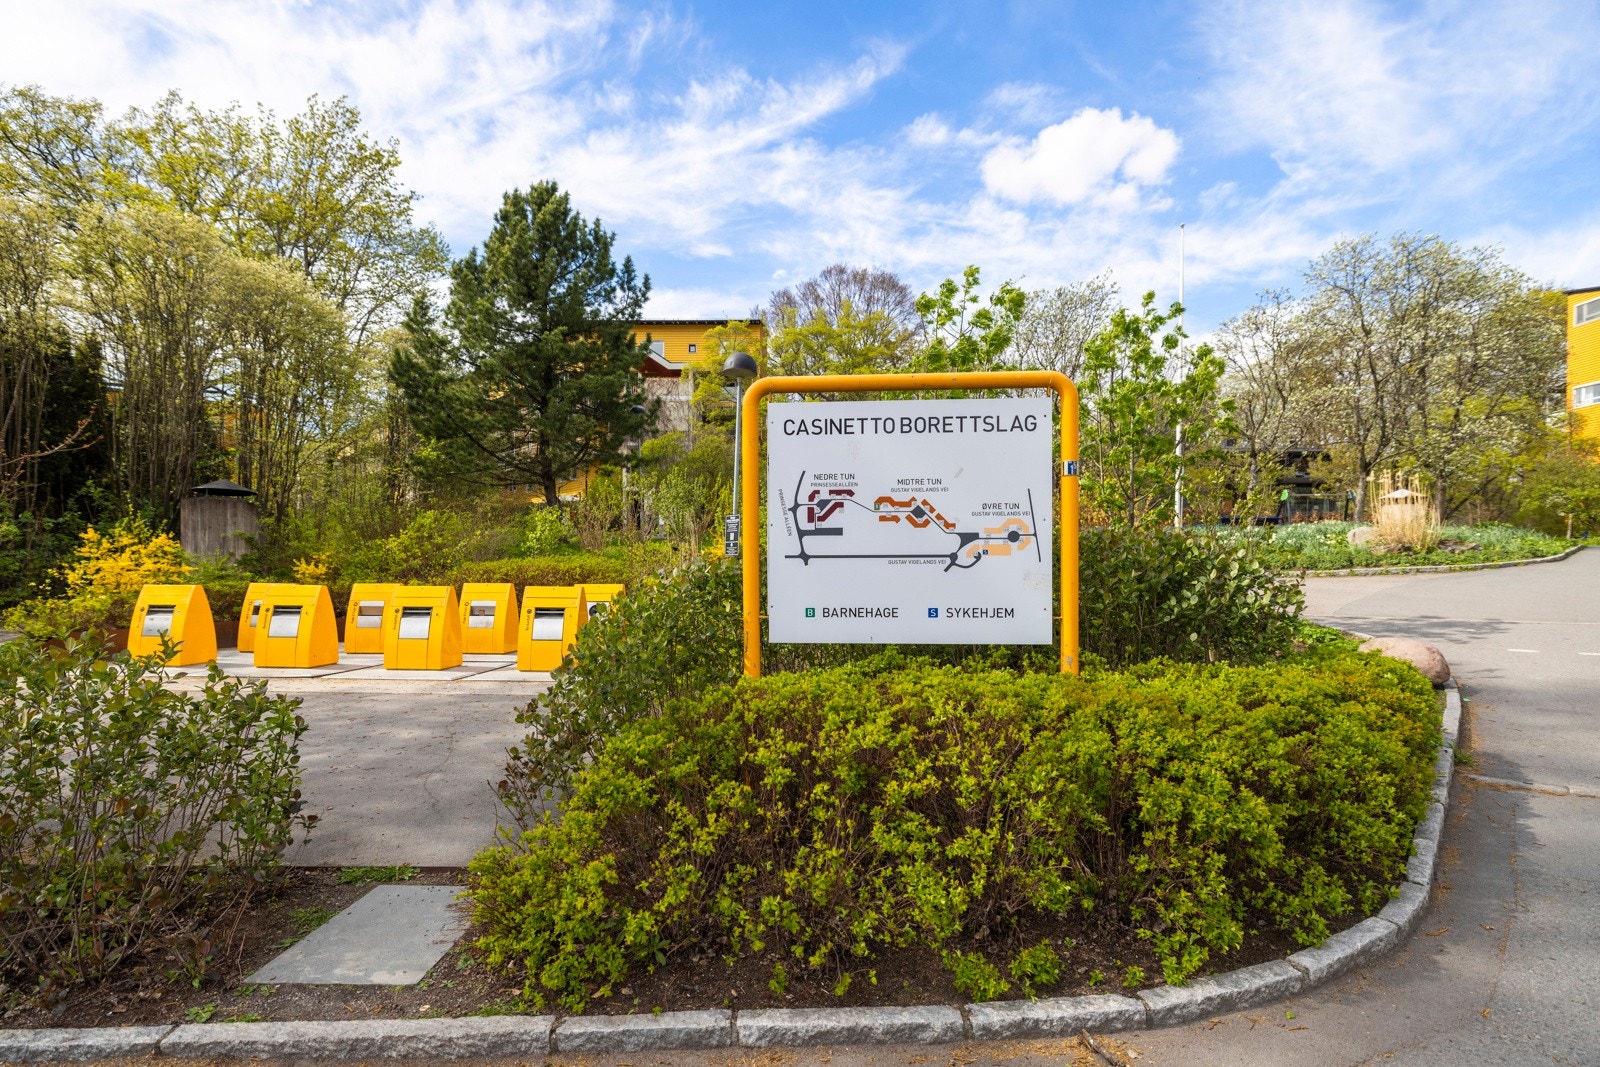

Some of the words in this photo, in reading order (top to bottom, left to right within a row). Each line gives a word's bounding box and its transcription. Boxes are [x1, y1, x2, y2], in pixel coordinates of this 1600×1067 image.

[783, 417, 896, 436] CASINETTO
[900, 414, 1038, 434] BORETTSLAG
[813, 473, 838, 481] NEDRE
[897, 478, 925, 486] MIDTRE
[981, 502, 1002, 510] ØVRE
[1003, 502, 1020, 510] TUN
[822, 607, 899, 618] BARNEHAGE
[946, 607, 1015, 618] SYKEHJEM
